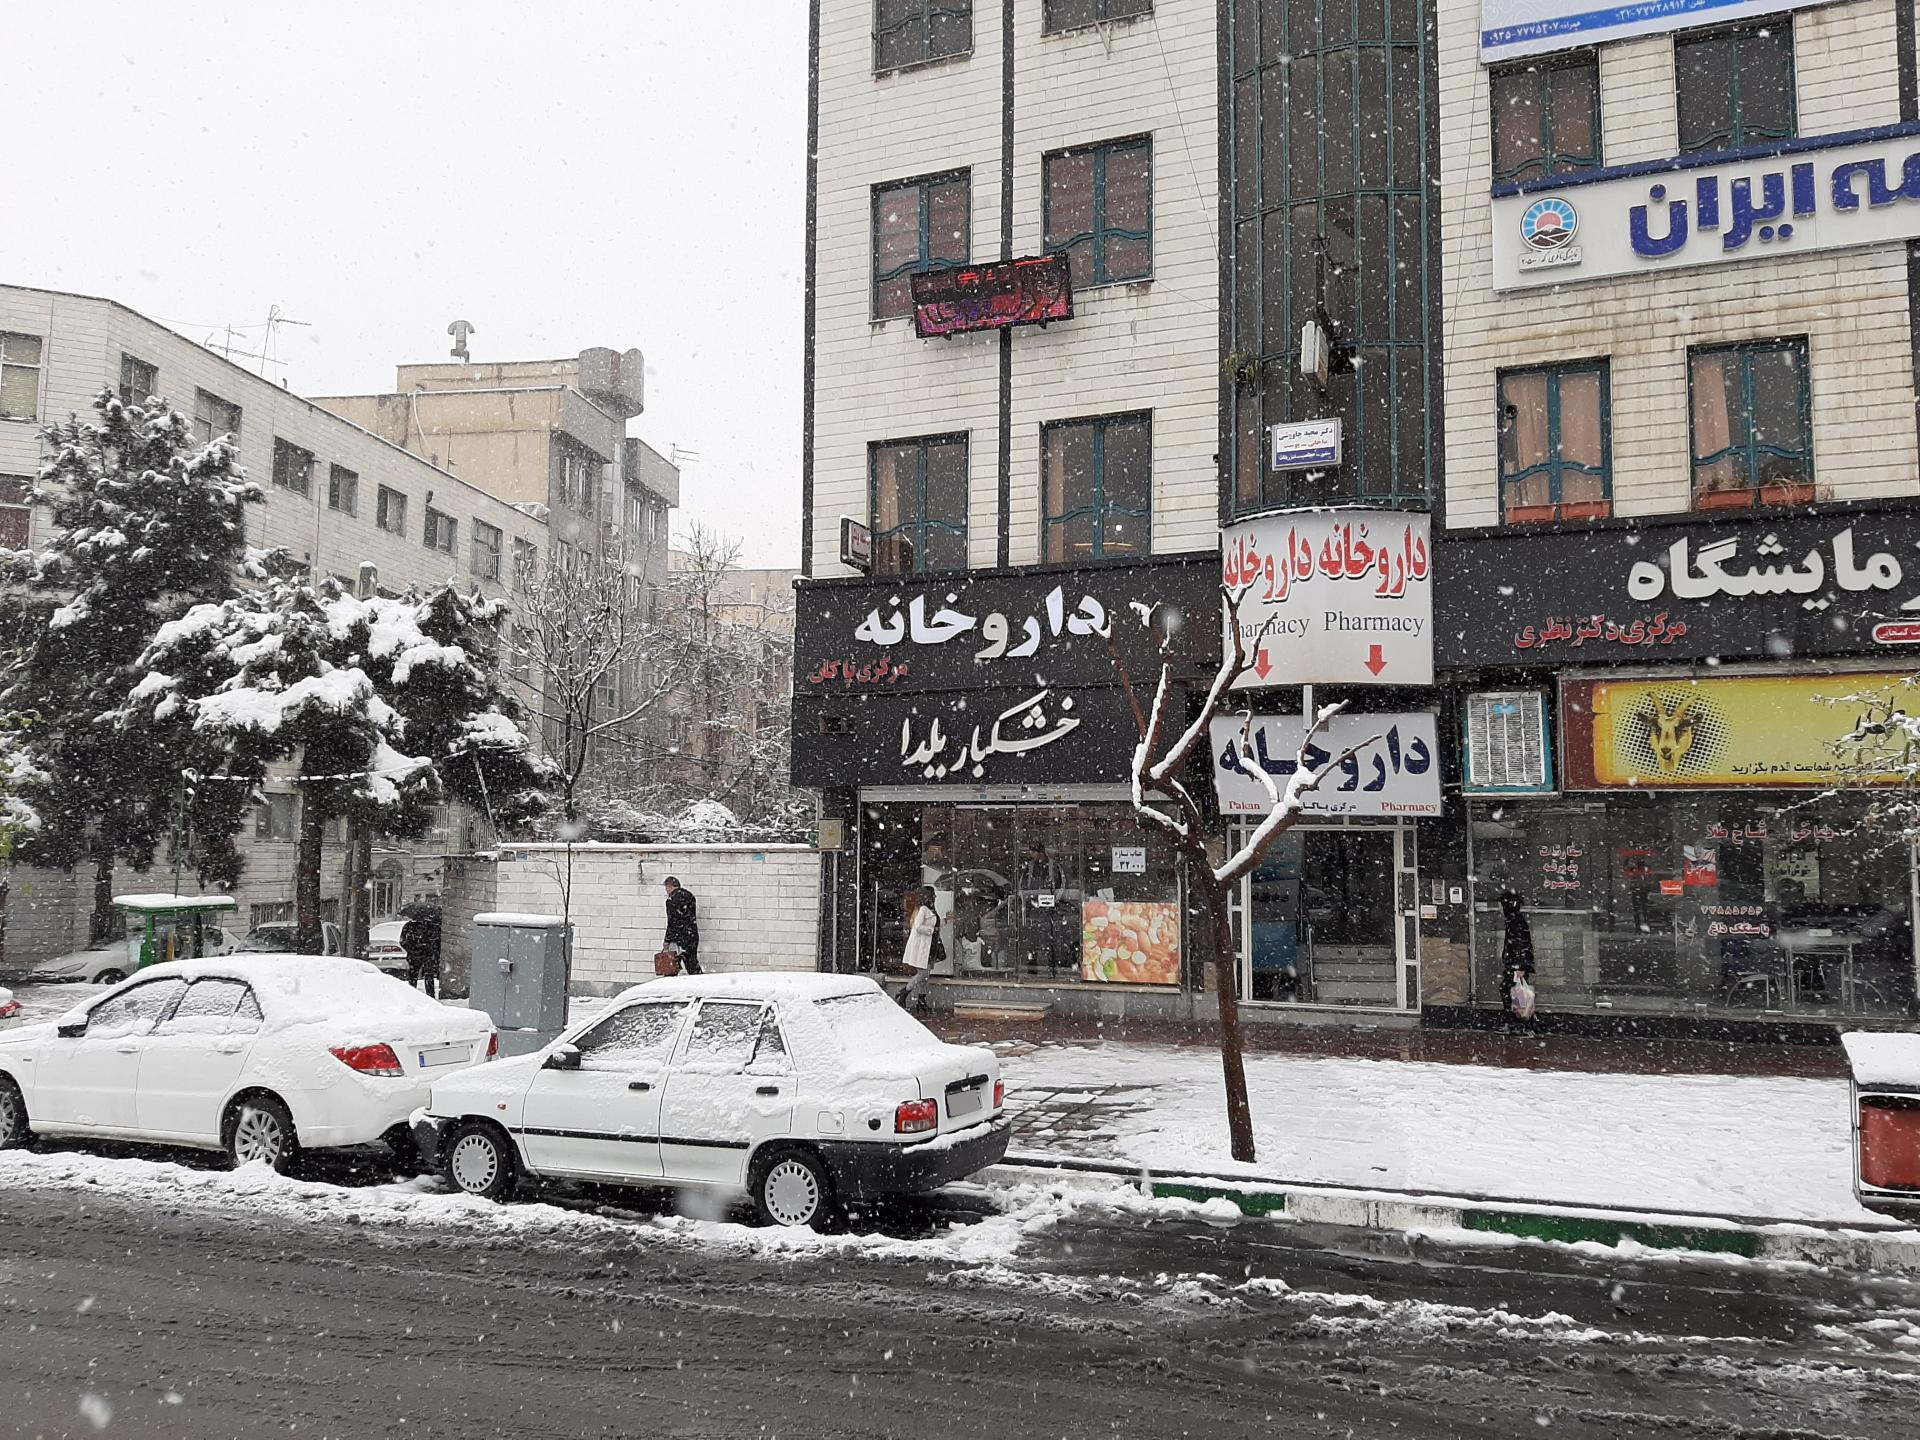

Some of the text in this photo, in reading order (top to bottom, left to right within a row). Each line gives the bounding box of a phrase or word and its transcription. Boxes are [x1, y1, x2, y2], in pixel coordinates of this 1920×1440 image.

[1628, 161, 1817, 259] ایران
[1223, 526, 1315, 605] داروخانه
[1318, 521, 1430, 598] داروخانه
[1627, 527, 1920, 612] مایشگاه
[854, 585, 1105, 659] داروخانه
[1323, 610, 1425, 637] Pharmacy
[1514, 611, 1688, 649] مرکزی دکتر نظری
[1380, 801, 1438, 814] Pharmacy
